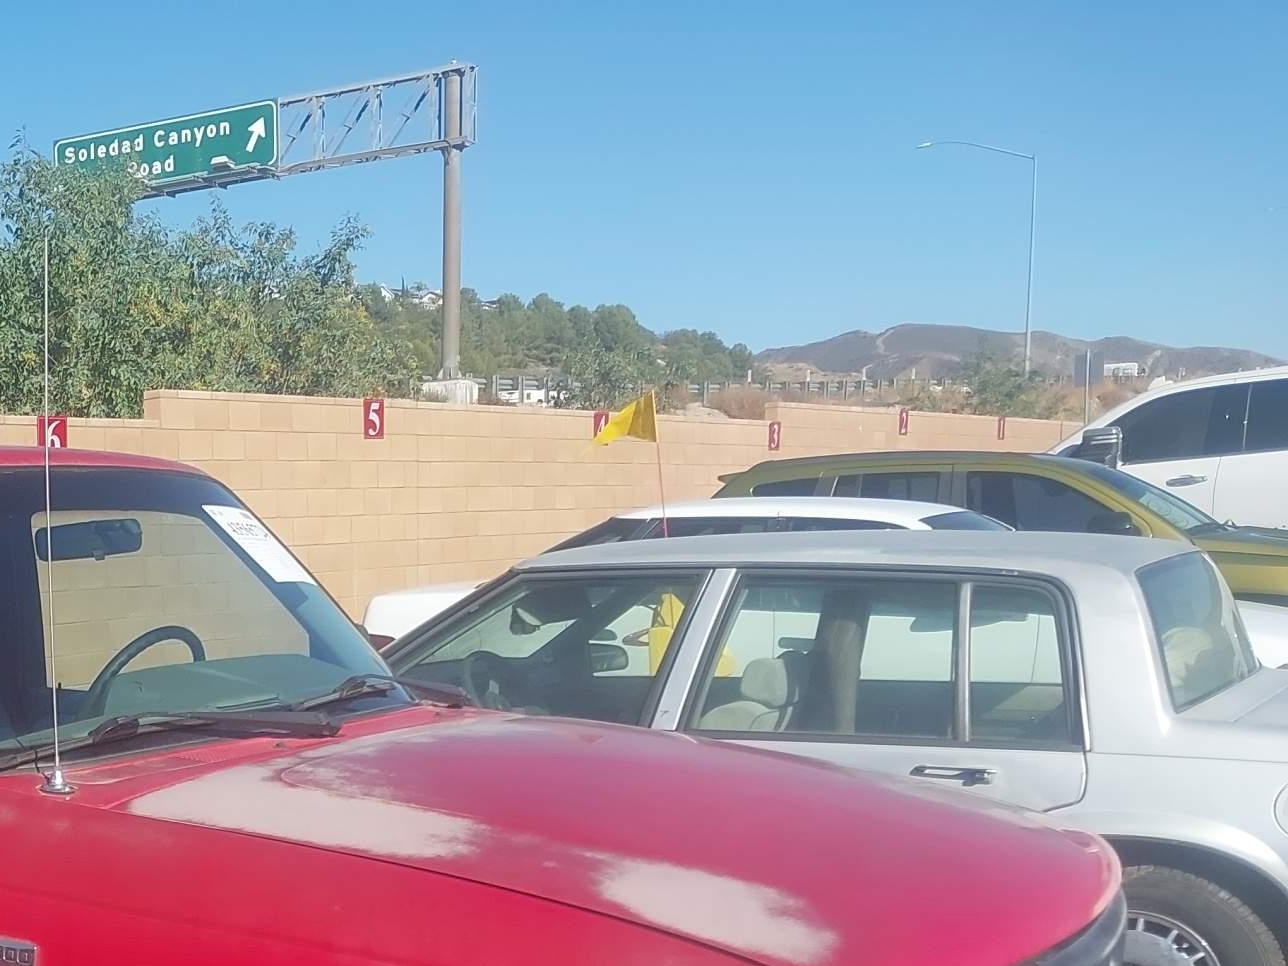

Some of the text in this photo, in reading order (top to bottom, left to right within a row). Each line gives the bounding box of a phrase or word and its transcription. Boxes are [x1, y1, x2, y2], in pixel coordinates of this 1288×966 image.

[64, 121, 230, 164] Soledad Canyon
[368, 402, 380, 436] 5
[901, 411, 907, 434] 2
[771, 424, 778, 448] 3
